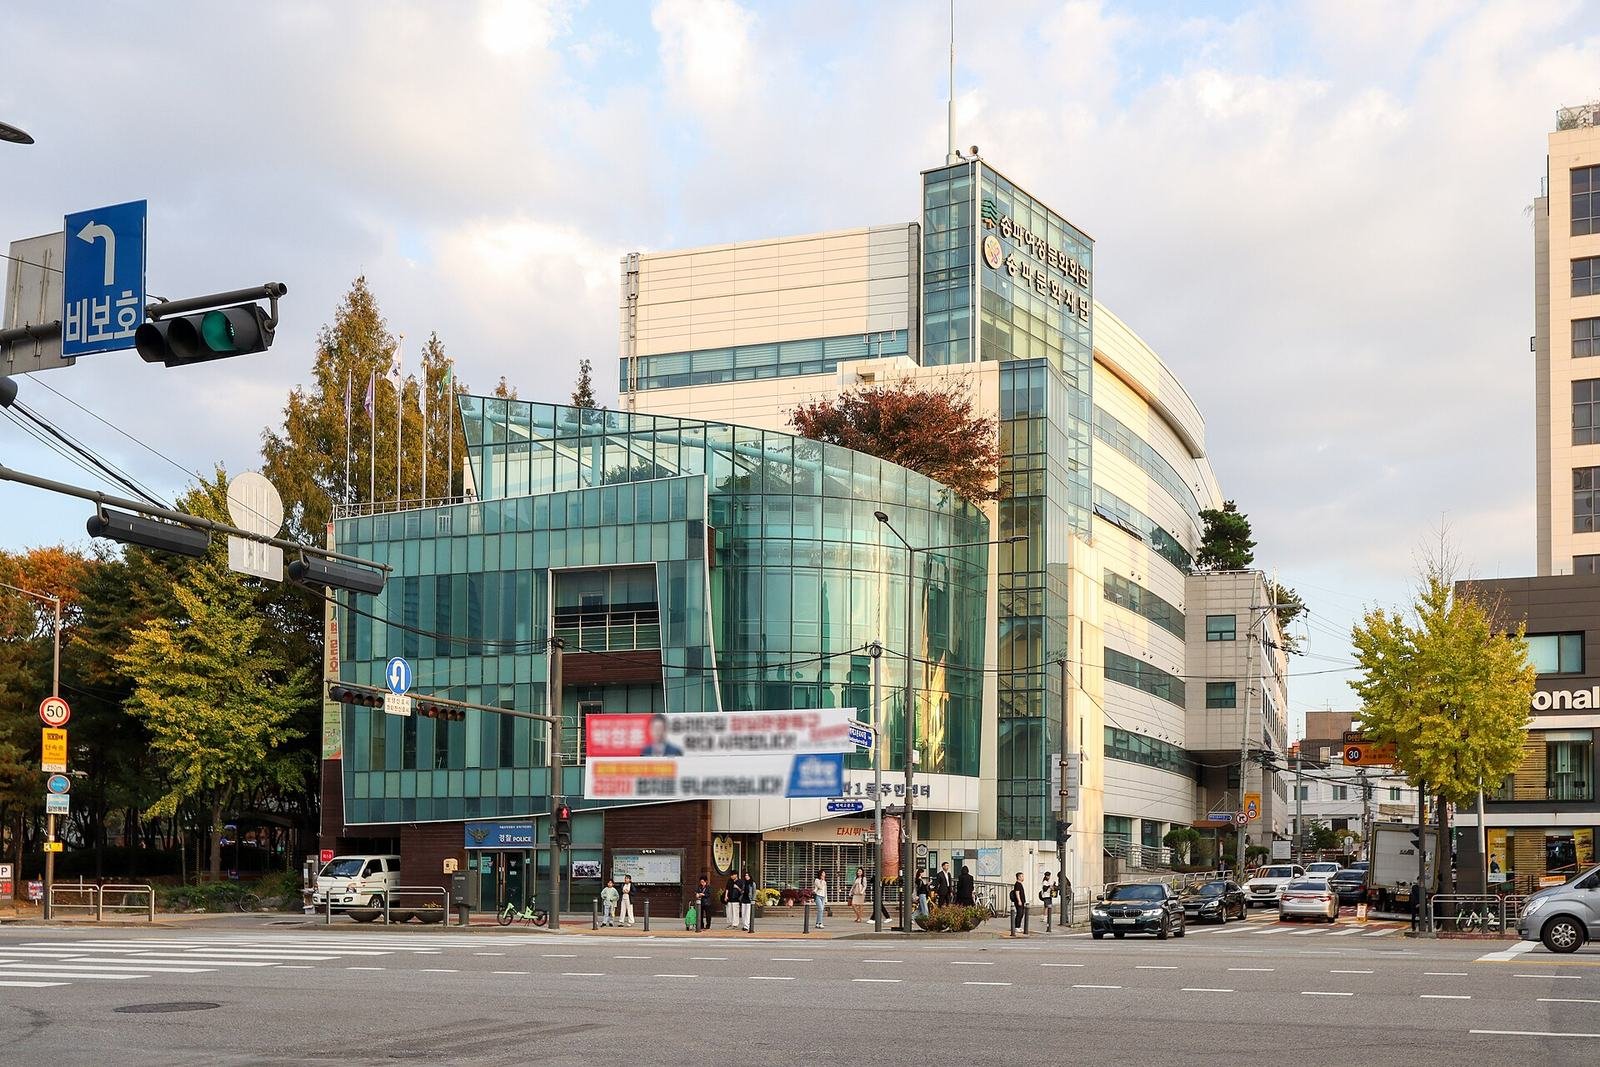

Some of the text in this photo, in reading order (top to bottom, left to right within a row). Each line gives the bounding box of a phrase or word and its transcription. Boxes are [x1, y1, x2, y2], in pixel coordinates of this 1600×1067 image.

[1000, 215, 1089, 289] 송파여성문화회관
[1005, 253, 1089, 323] 송파문화재단
[66, 290, 138, 344] 비보호
[46, 705, 64, 718] 50
[1348, 750, 1359, 760] 30
[499, 834, 512, 843] 경찰
